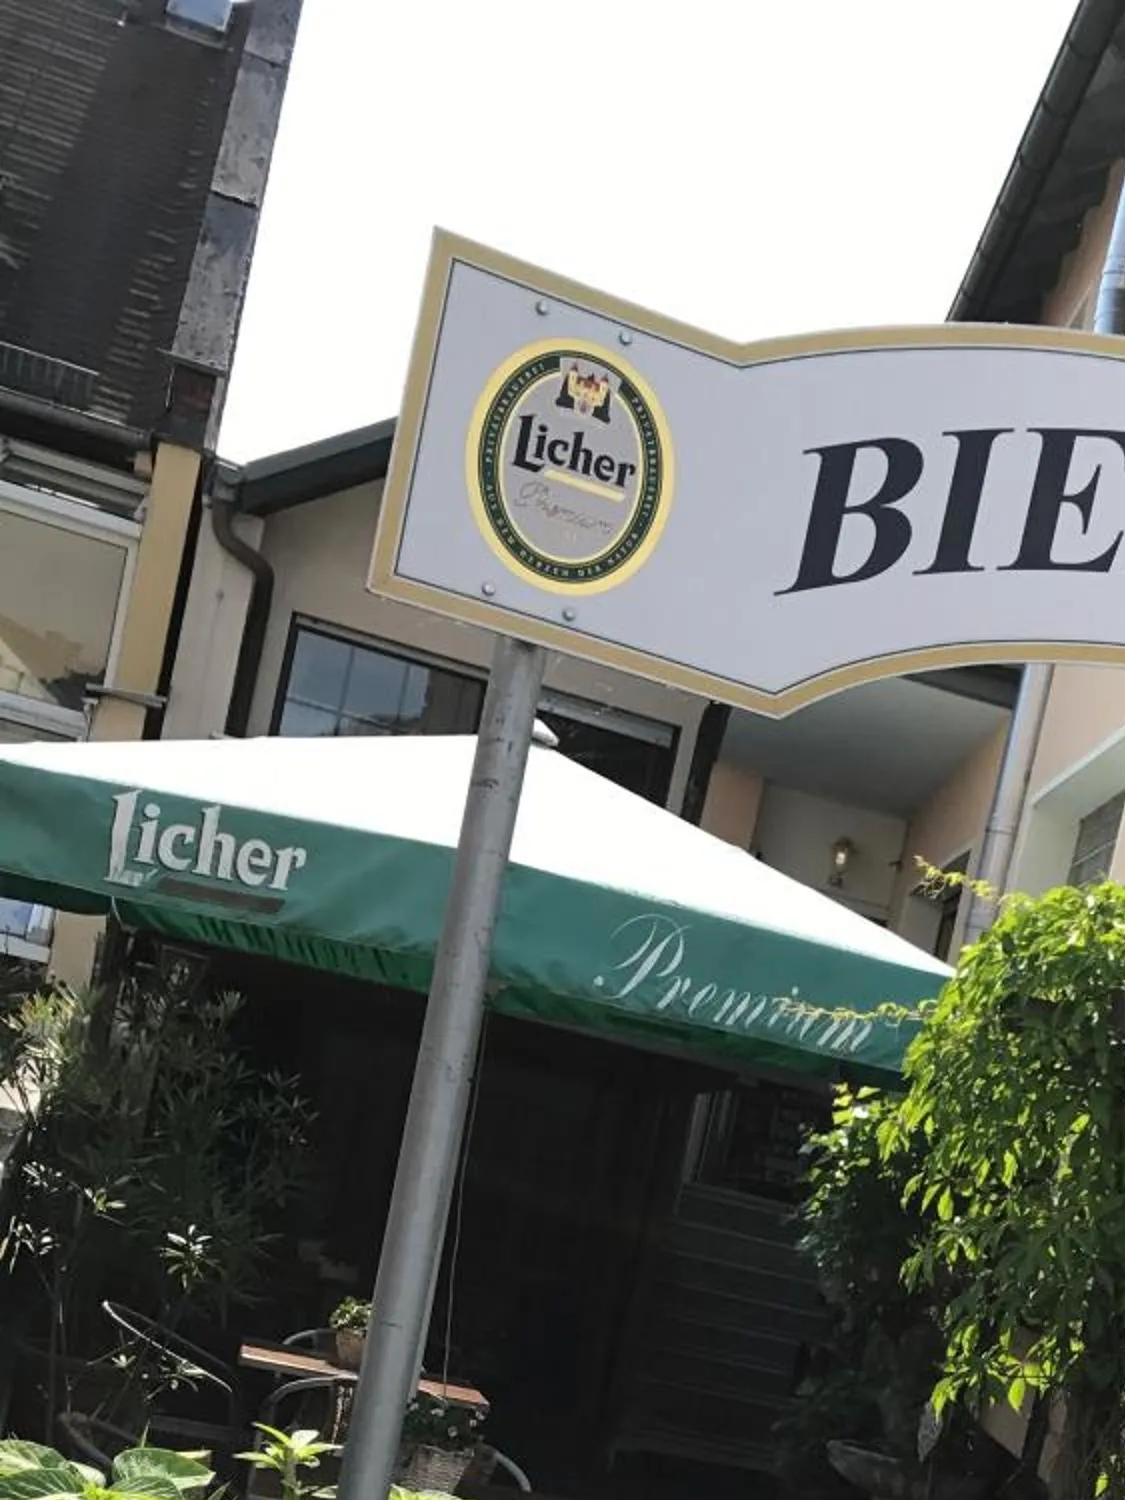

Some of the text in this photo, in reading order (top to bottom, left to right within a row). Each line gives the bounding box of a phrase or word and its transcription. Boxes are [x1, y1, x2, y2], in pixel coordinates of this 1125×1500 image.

[512, 413, 636, 488] Licher
[104, 789, 308, 891] Licher
[593, 913, 875, 1053] Premium
